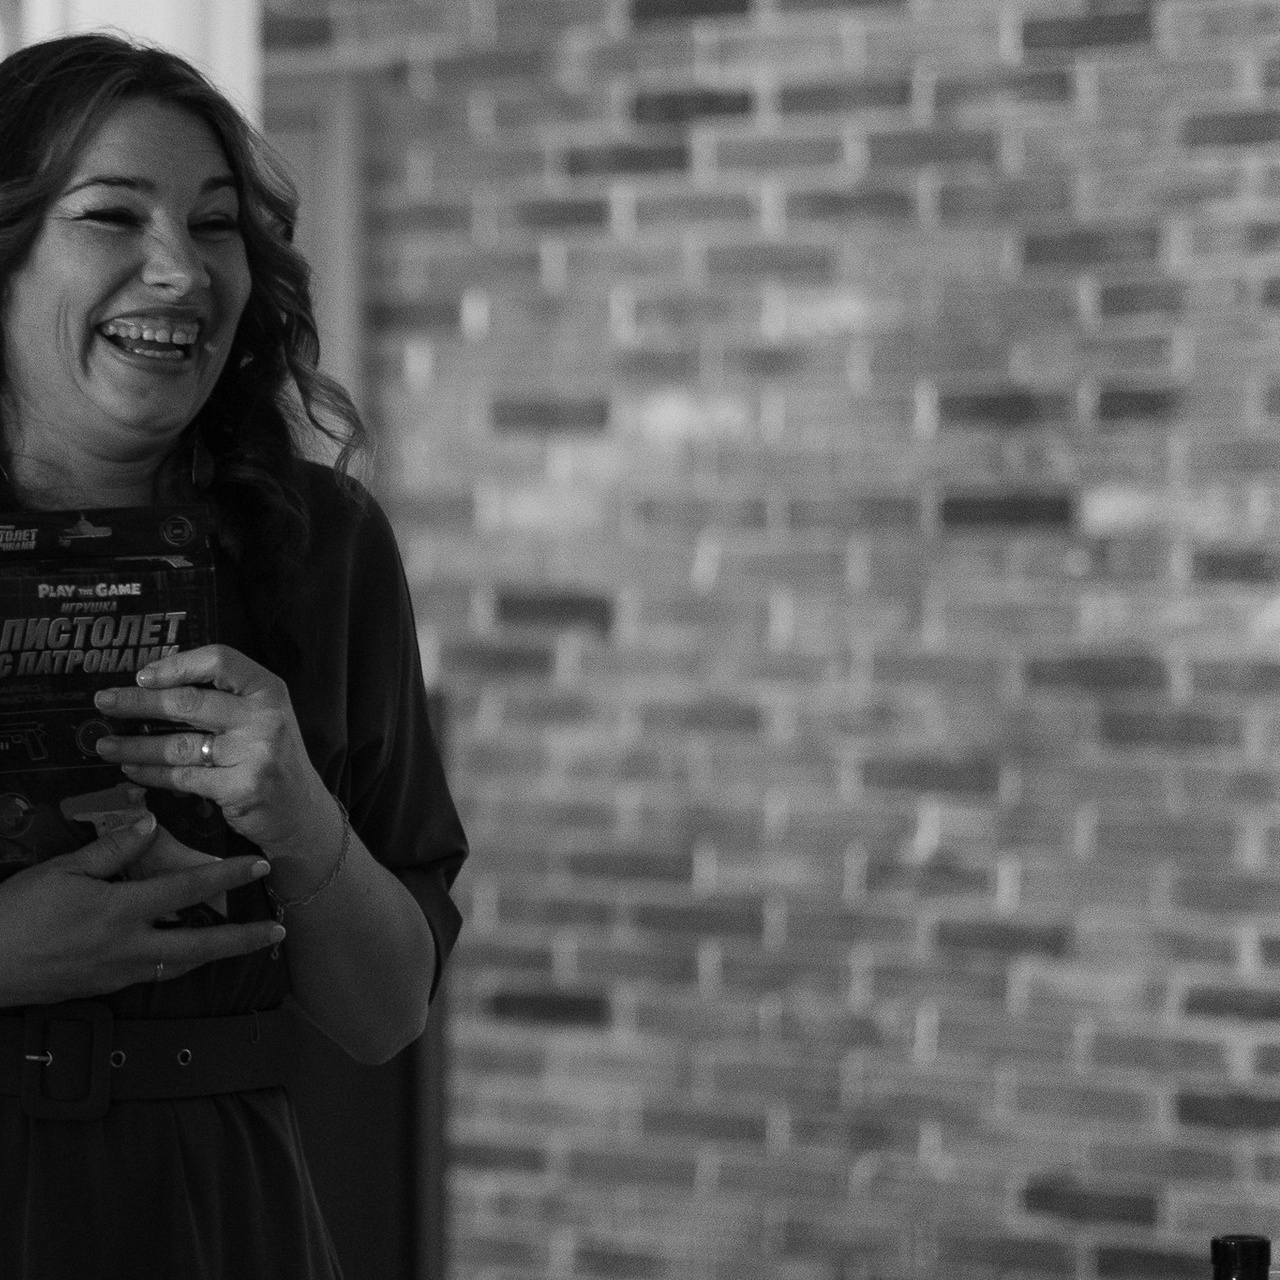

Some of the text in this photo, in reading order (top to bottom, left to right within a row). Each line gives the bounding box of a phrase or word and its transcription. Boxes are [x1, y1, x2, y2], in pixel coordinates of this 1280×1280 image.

[38, 583, 142, 599] PLAY THE GAME
[60, 601, 118, 614] ИГРУШКА
